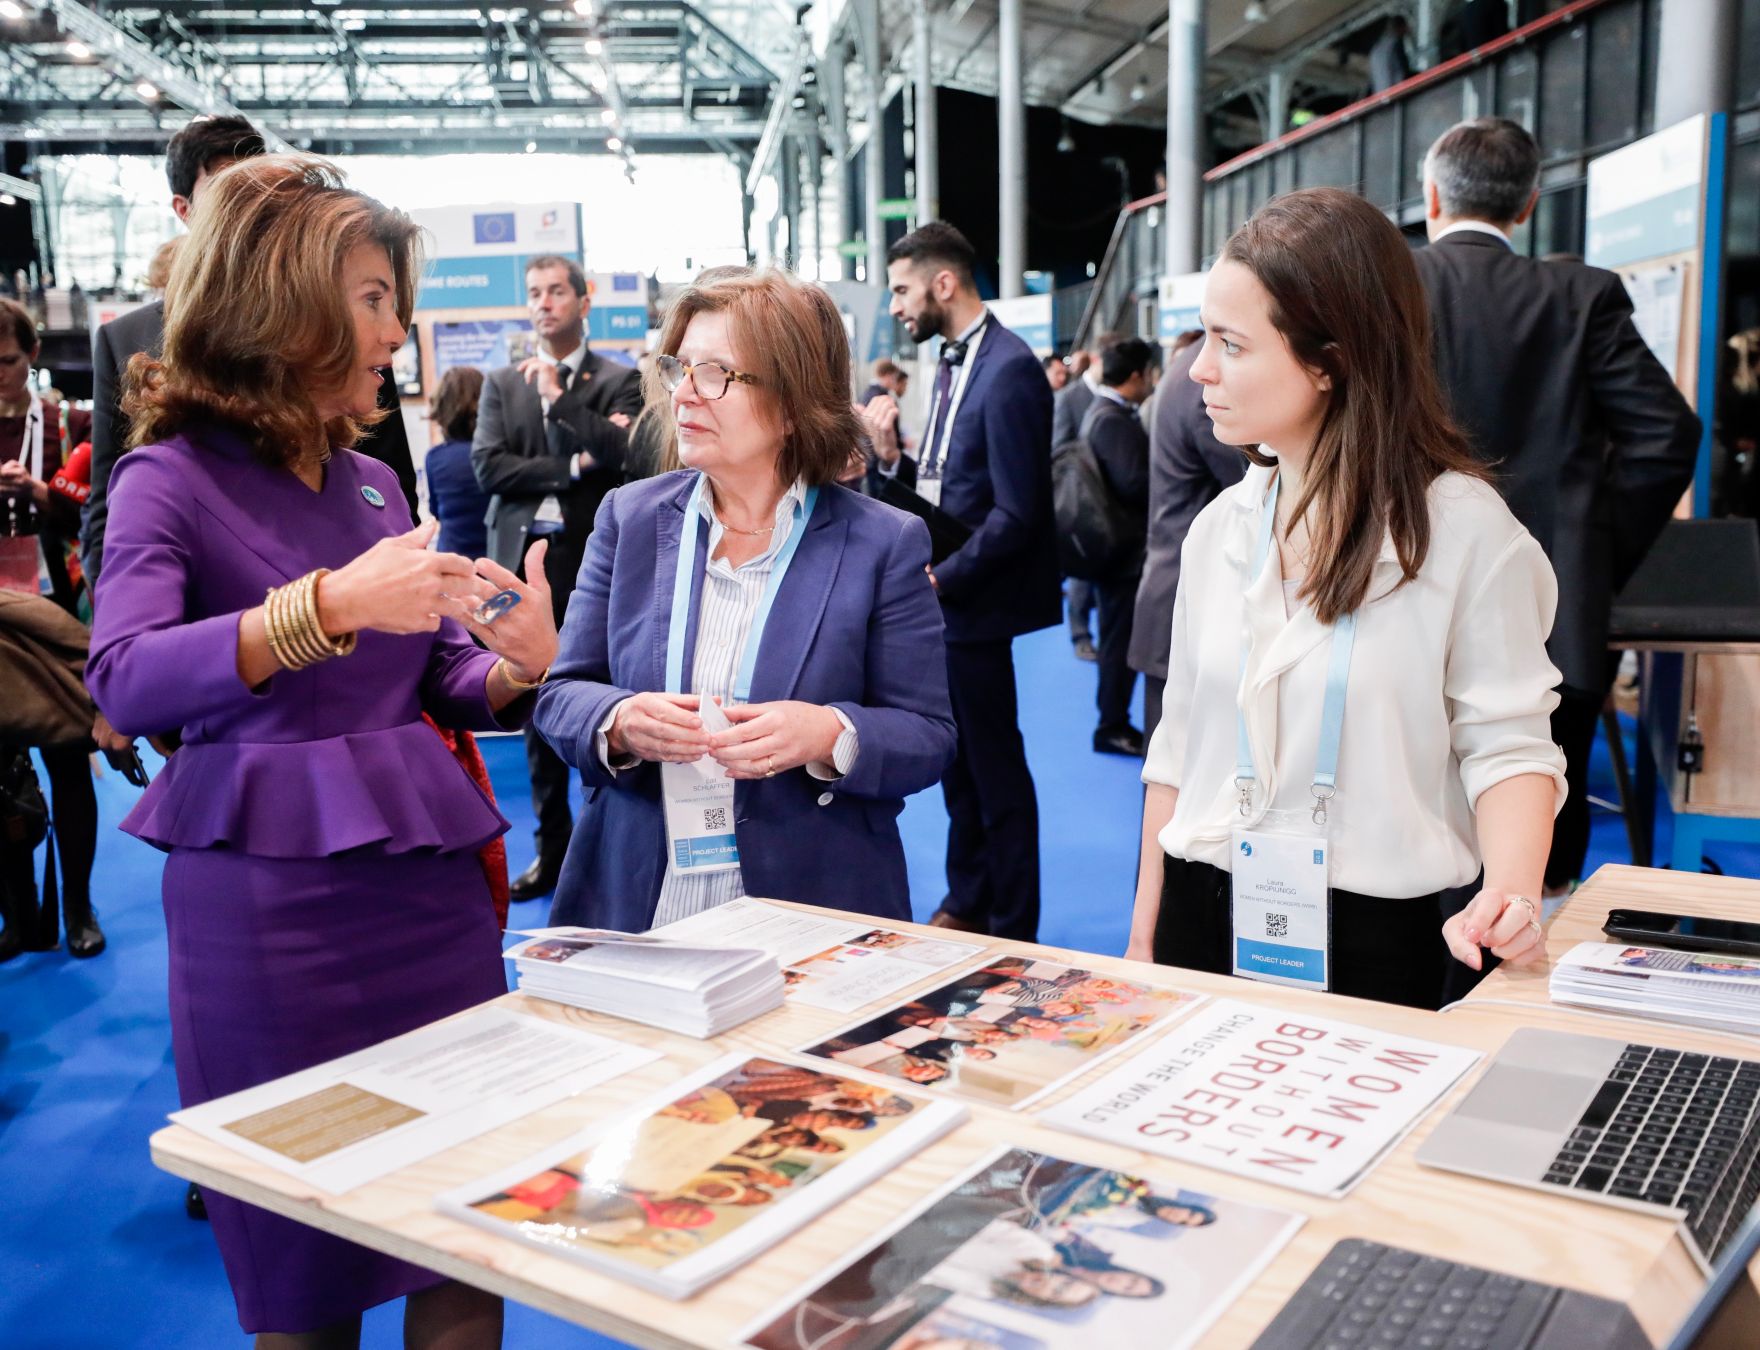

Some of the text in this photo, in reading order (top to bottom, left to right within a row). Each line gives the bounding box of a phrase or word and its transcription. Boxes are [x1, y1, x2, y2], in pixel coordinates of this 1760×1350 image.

[55, 476, 88, 497] ORF
[692, 845, 738, 856] PROJECT LEADE
[1267, 878, 1284, 887] Laura
[1251, 953, 1305, 968] PROJECT LEADER
[1081, 1013, 1255, 1124] CHANGE THE WORLD
[1137, 1021, 1329, 1144] BORDERS
[1202, 1036, 1373, 1158] WITHOUT
[1248, 1047, 1438, 1176] WOMEN
